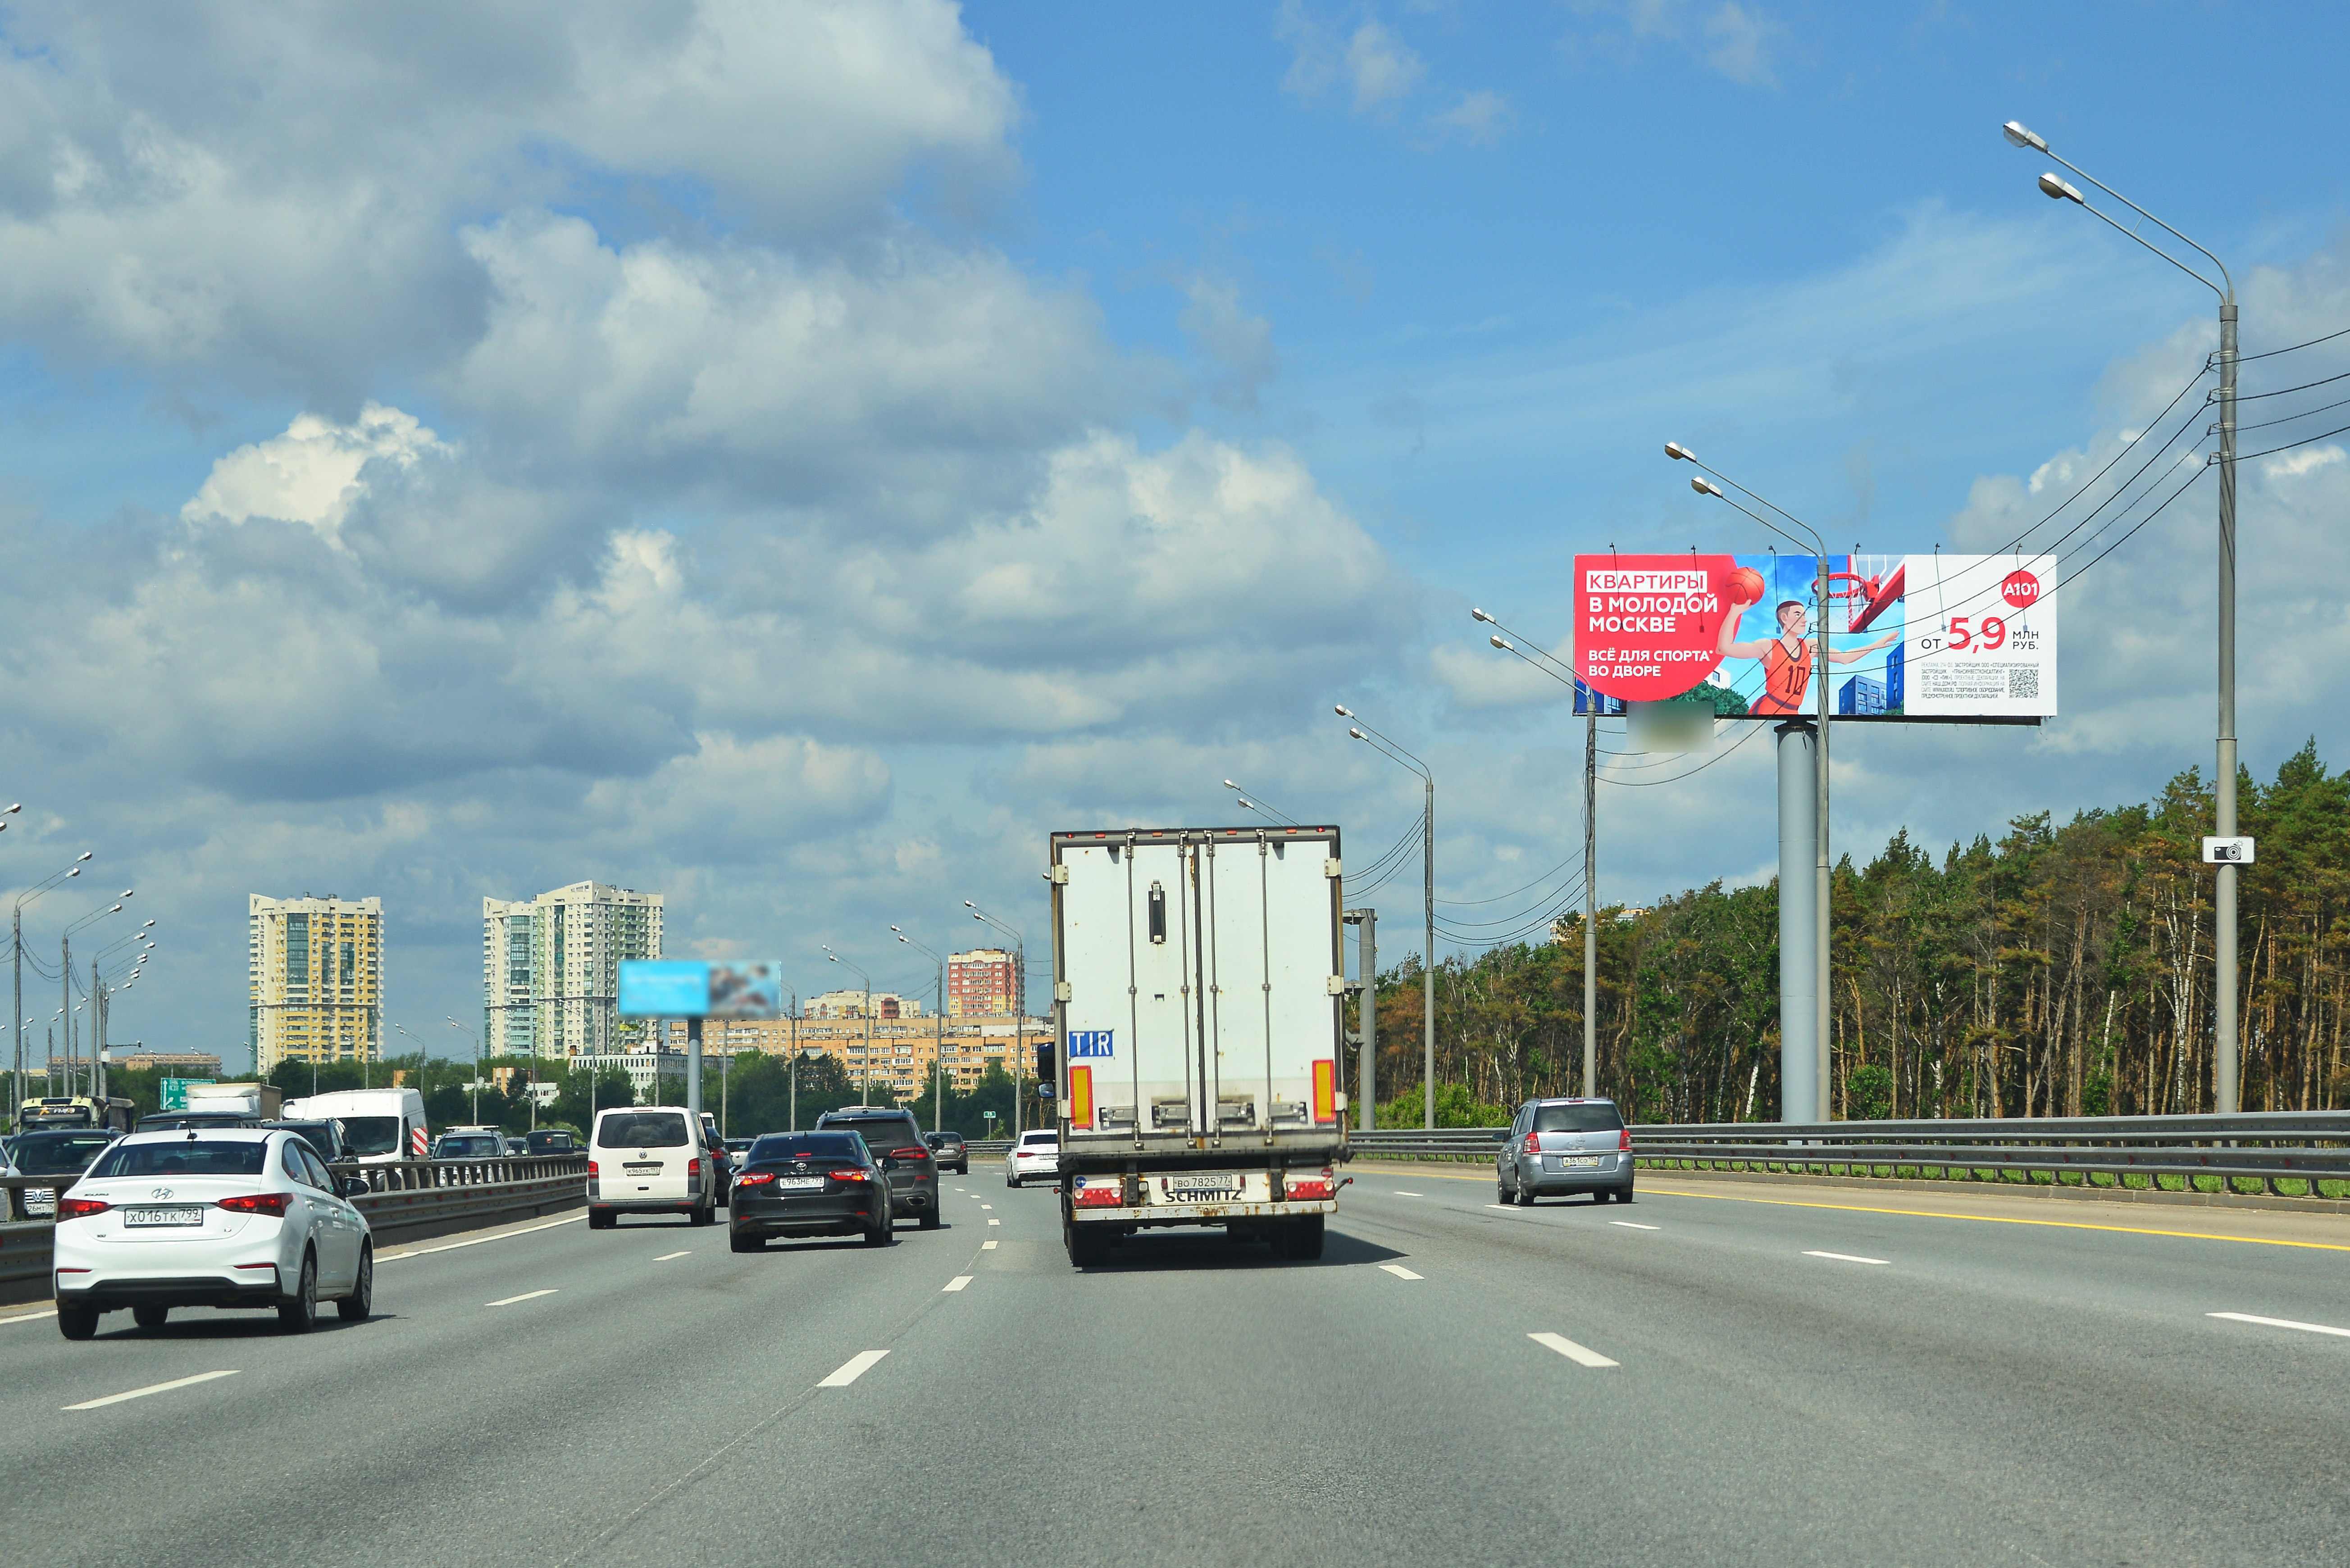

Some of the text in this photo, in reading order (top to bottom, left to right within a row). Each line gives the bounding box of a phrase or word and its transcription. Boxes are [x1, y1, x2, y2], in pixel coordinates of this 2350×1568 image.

[1589, 575, 1703, 589] КВАРТИРЫ
[1589, 593, 1717, 615] В МОЛОДОЙ
[1589, 617, 1676, 632] МОСКВЕ
[1922, 617, 2006, 654] ОТ 5,9
[2013, 631, 2039, 640] МЛН
[1589, 648, 1616, 661] ВСЁ
[1619, 650, 1649, 663] ДЛЯ
[1589, 665, 1661, 678] ВО ДВОРЕ
[1072, 1032, 1110, 1056] TIR
[1192, 1177, 1216, 1187] 7825
[1165, 1189, 1242, 1202] SCHMITZ
[130, 1209, 199, 1223] Х016ТК 799
